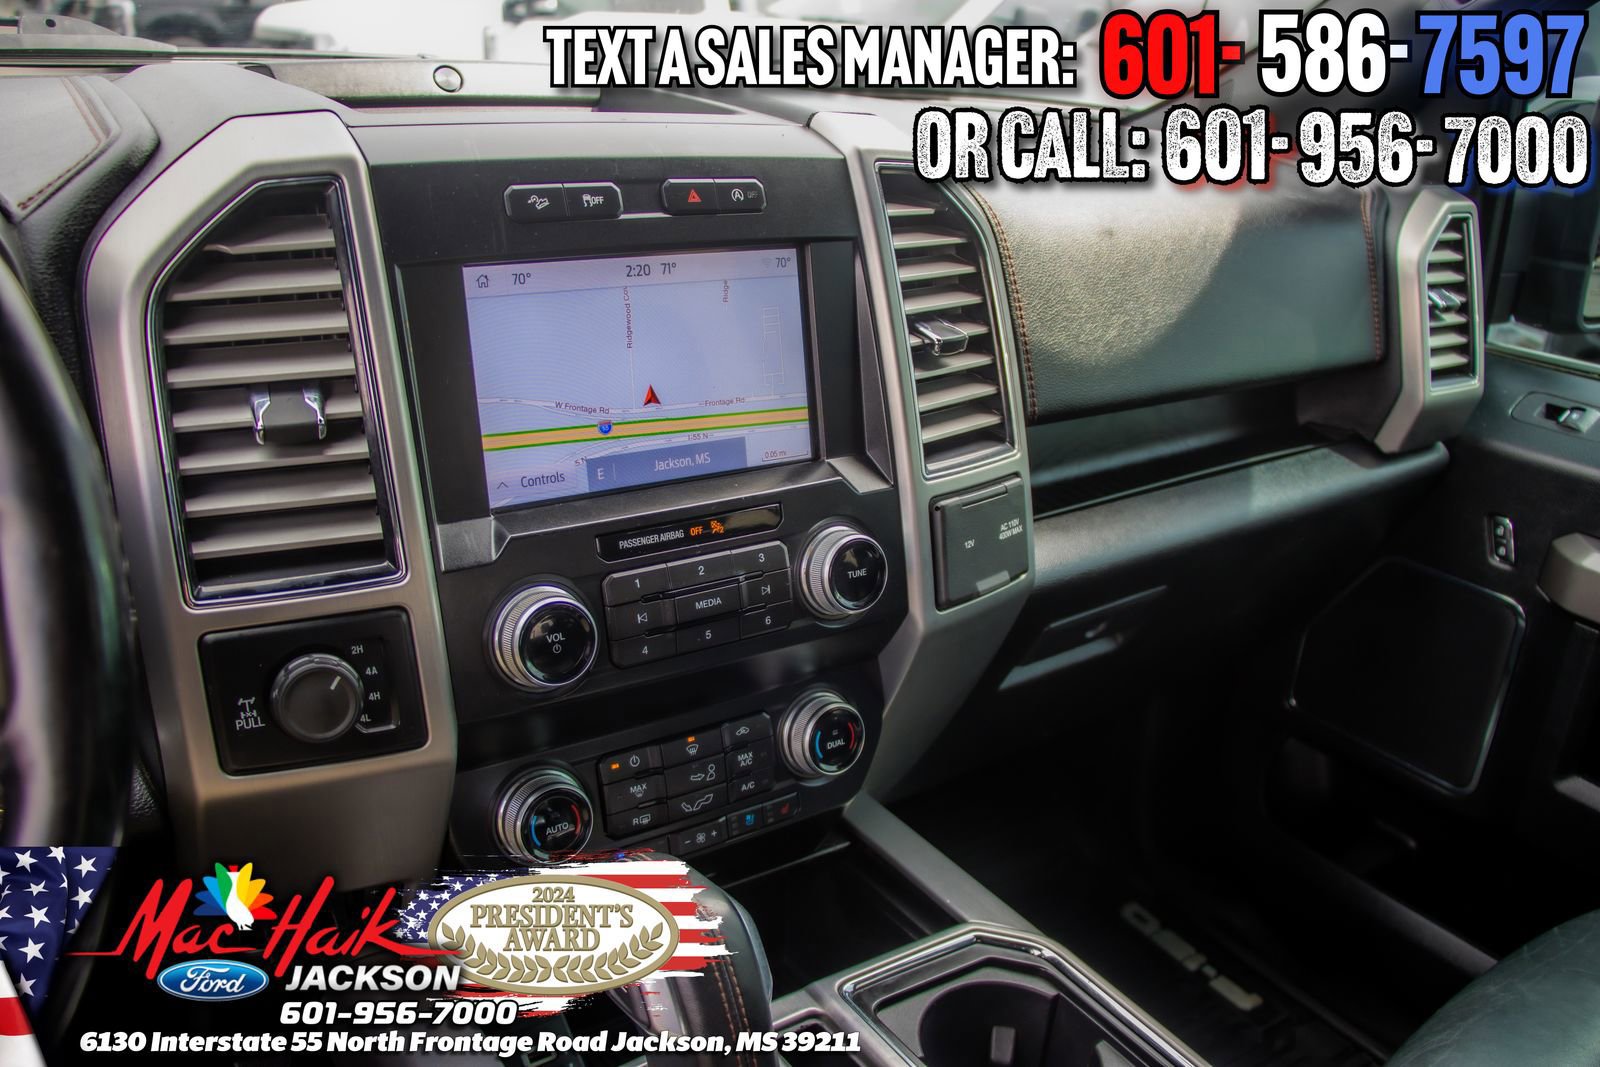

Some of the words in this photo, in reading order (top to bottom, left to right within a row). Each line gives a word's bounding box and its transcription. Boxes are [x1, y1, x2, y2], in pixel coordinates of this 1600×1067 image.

[591, 196, 604, 205] OFF
[660, 262, 677, 275] 71°
[775, 257, 791, 269] 70°
[625, 264, 651, 278] 2:20
[511, 272, 532, 286] 70°
[625, 303, 633, 349] Ridgewood
[555, 401, 563, 409] W
[564, 403, 597, 415] Frontage
[599, 407, 610, 415] Rd
[704, 398, 734, 407] Frontage
[654, 458, 695, 472] Jackson,
[695, 452, 711, 465] MS
[520, 471, 566, 488] Controls
[597, 468, 606, 480] E
[619, 534, 659, 550] PASSENGER
[660, 529, 685, 542] AIRBAG
[689, 526, 703, 537] OFF
[964, 539, 976, 549] 12V
[759, 553, 765, 563] 3
[698, 566, 705, 576] 2
[847, 567, 868, 580] TUNE
[635, 578, 641, 588] 1
[695, 596, 723, 610] MEDIA
[765, 616, 771, 626] 6
[546, 633, 566, 644] VOL
[705, 629, 712, 640] 5
[351, 644, 364, 655] 2H
[641, 645, 649, 656] 4
[365, 666, 378, 676] 4A
[368, 691, 381, 702] 4H
[360, 714, 372, 724] 4L
[235, 719, 266, 731] PULL
[827, 738, 846, 750] DUAL
[737, 751, 753, 762] MAX
[740, 758, 753, 767] A/C
[630, 782, 648, 794] MAX
[741, 781, 756, 792] A/C
[545, 822, 570, 836] AUTO
